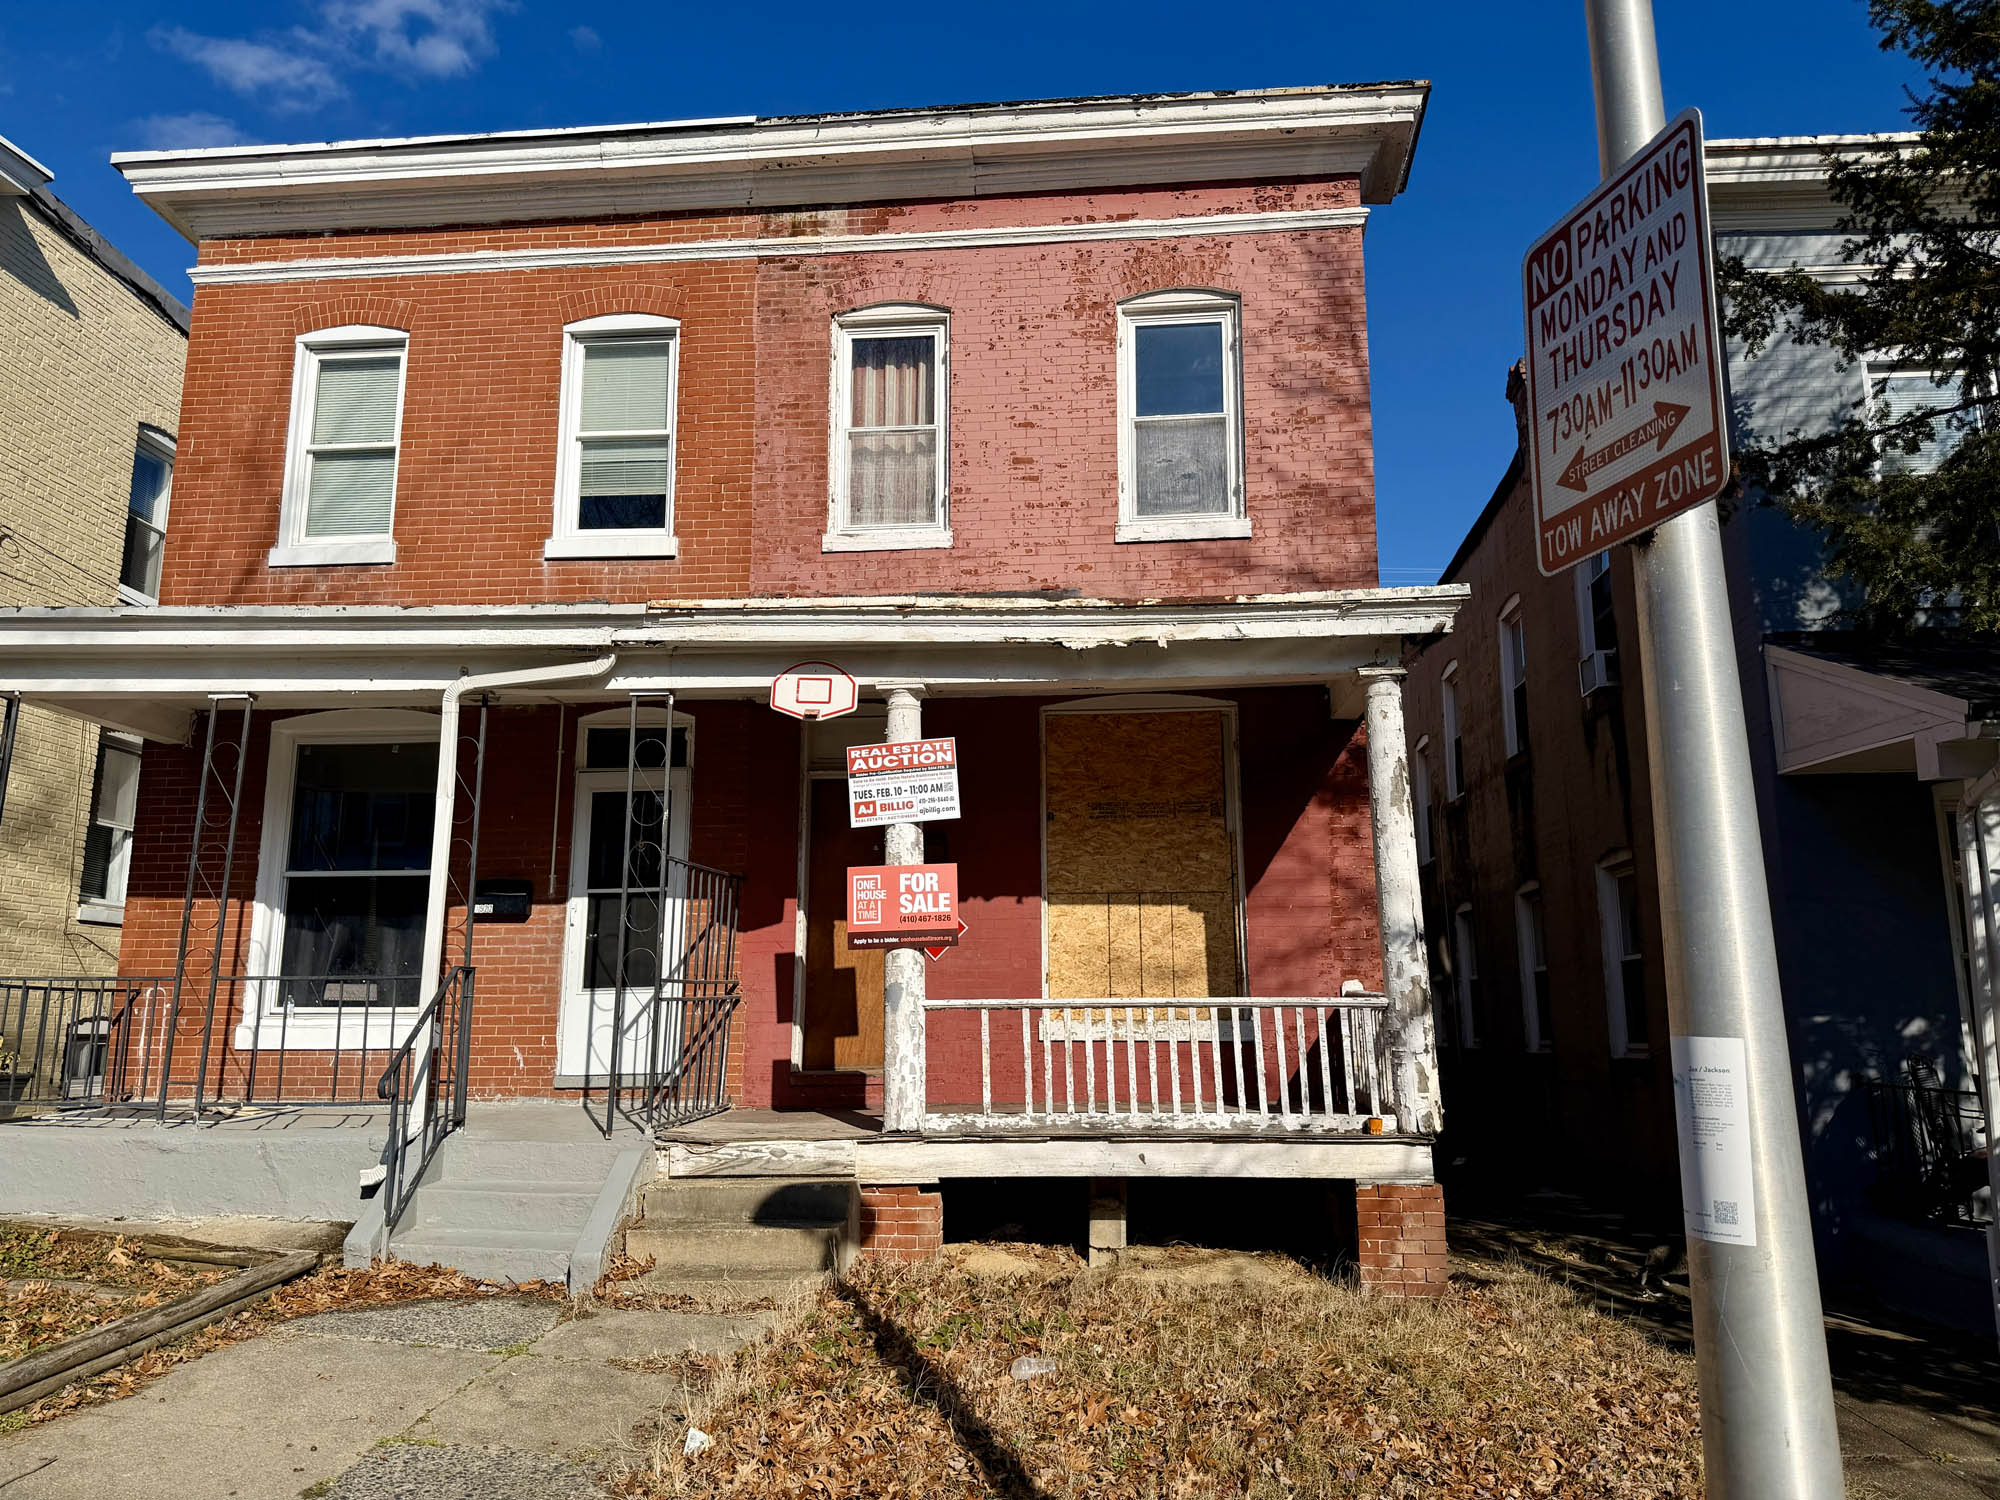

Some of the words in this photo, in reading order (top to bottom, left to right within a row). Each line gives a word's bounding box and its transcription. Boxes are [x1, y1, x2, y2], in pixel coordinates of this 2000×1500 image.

[1532, 240, 1569, 301] NO
[1577, 140, 1690, 268] PARKING
[1541, 236, 1638, 347] MONDAY
[1644, 211, 1686, 274] AND
[1550, 260, 1680, 389] THURSDAY
[1547, 324, 1698, 453] 730AM-1130AM
[1568, 451, 1609, 483] STREET
[1614, 411, 1676, 457] CLEANING
[1545, 515, 1582, 562] TOW
[1591, 482, 1647, 541] AWAY
[1654, 447, 1717, 510] ZONE
[850, 747, 890, 759] REAL
[893, 741, 952, 754] ESTATE
[851, 750, 952, 771] AUCTION
[853, 791, 876, 801] TUES.
[876, 788, 893, 798] FEB.
[894, 787, 903, 796] 10
[909, 784, 929, 795] 11:00
[930, 783, 944, 793] AM
[857, 804, 874, 815] AJ
[879, 801, 914, 812] BILLIG
[919, 806, 956, 815] ajbillig.com
[857, 879, 876, 890] ONE
[899, 872, 939, 893] FOR
[857, 889, 887, 900] HOUSE
[899, 892, 951, 914] SALE
[857, 901, 867, 910] AT
[869, 901, 876, 909] A
[857, 910, 877, 920] TIME
[899, 915, 918, 924] (410)
[918, 914, 952, 922] 467-1826
[1703, 1065, 1731, 1073] Jackson
